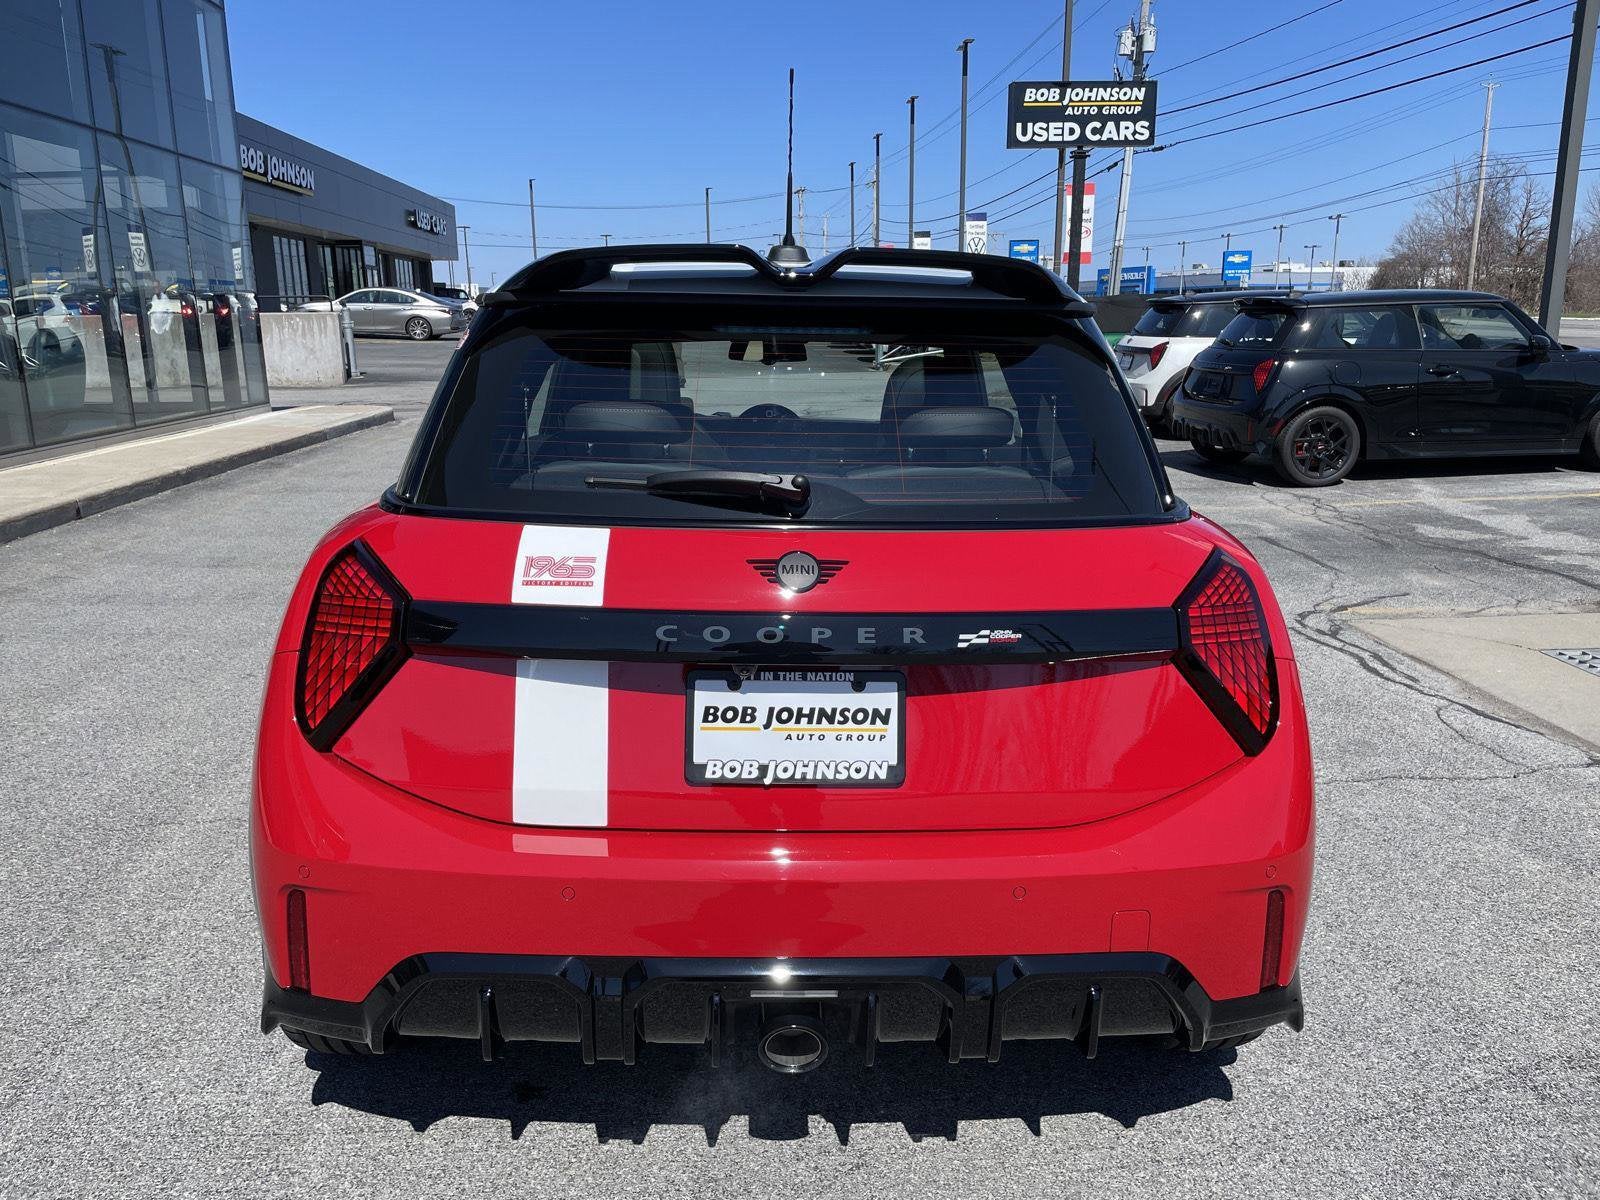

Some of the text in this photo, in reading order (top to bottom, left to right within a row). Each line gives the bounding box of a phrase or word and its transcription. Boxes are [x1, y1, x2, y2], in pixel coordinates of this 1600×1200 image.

[1024, 87, 1146, 105] BOB JOHNSON
[1065, 105, 1142, 116] AUTO GROUP
[1015, 121, 1150, 142] USED CARS
[240, 144, 315, 191] BOB JOHNSON
[415, 209, 447, 236] USED CARS
[523, 556, 597, 578] 1965
[782, 564, 815, 575] MINI
[655, 625, 927, 644] COOPER
[760, 671, 774, 681] IN
[779, 672, 803, 681] THE
[807, 672, 855, 682] NATION
[702, 705, 892, 730] BOB JOHNSON
[785, 733, 887, 742] AUTO GROUP
[705, 760, 889, 785] BOB JOHNSON
